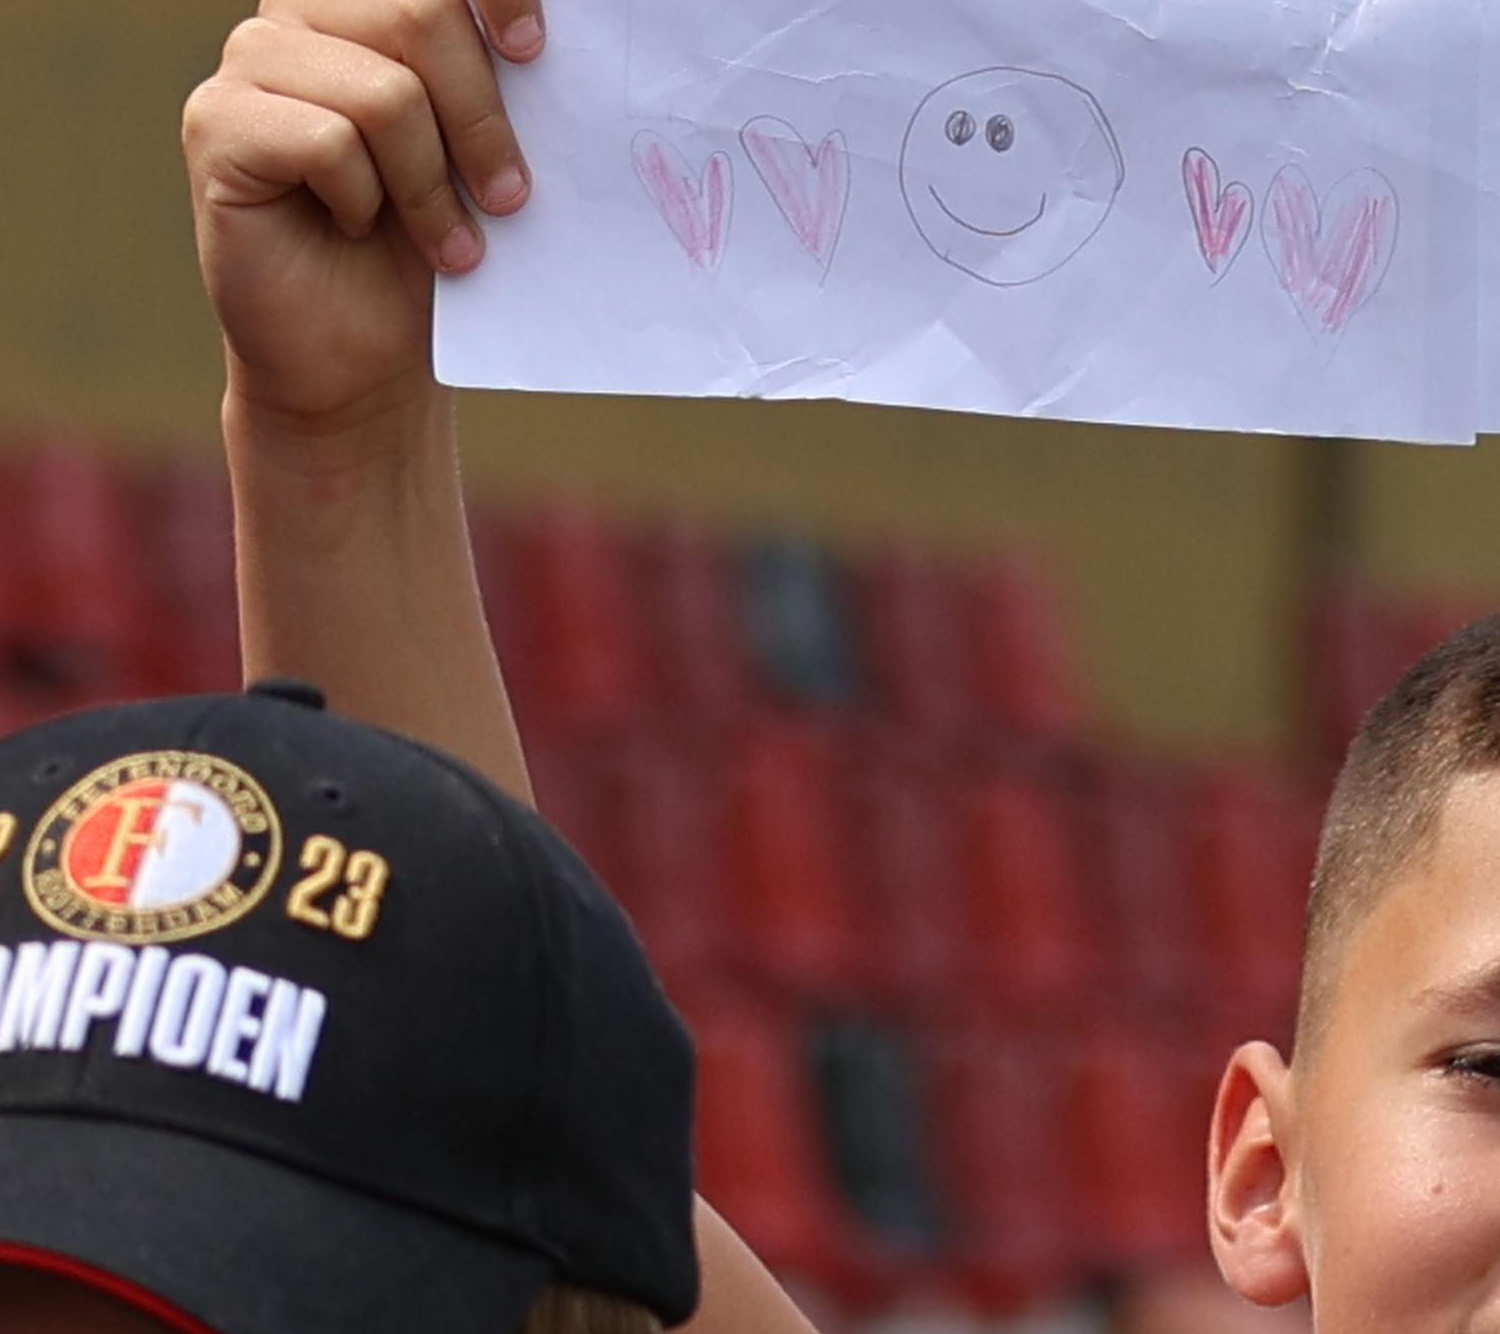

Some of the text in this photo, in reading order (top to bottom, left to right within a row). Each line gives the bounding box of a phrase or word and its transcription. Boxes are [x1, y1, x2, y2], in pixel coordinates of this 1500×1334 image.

[57, 755, 268, 835] FEYENOORD
[34, 869, 246, 935] ROTTERDAM
[286, 833, 391, 941] 23
